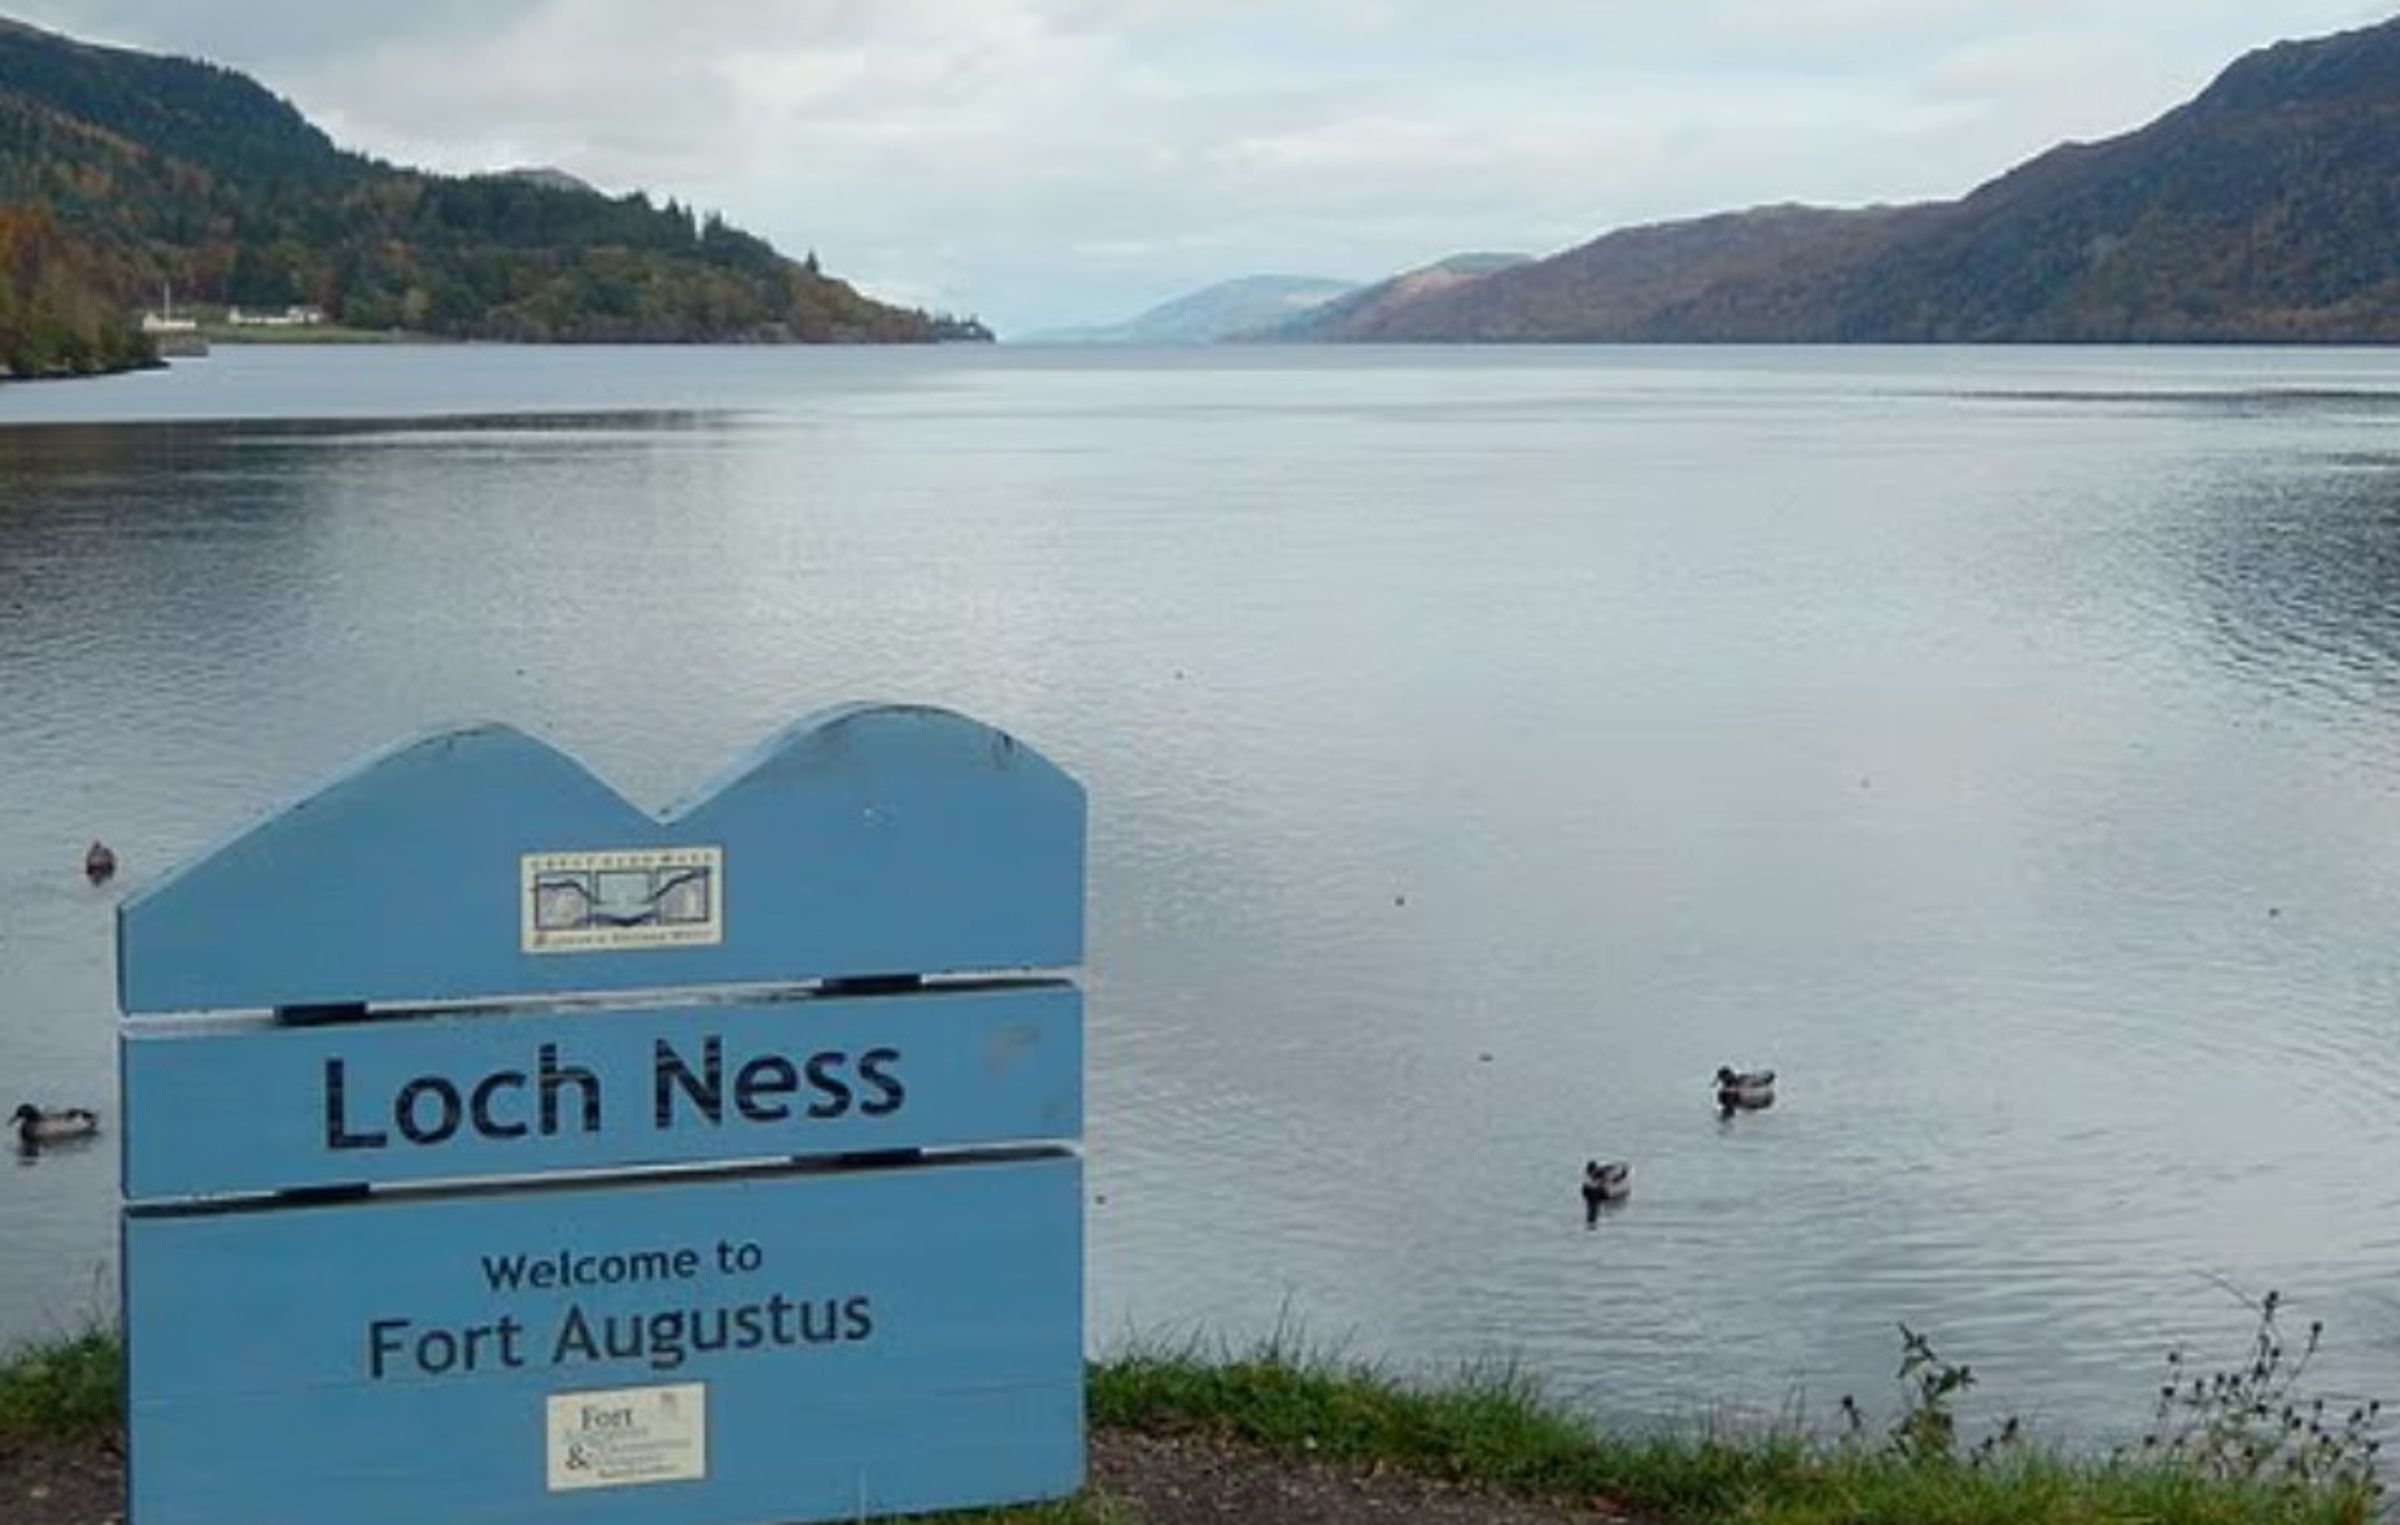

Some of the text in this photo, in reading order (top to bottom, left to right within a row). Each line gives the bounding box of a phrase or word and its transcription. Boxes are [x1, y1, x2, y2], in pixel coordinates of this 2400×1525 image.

[325, 1036, 905, 1150] Loch Ness
[482, 1241, 762, 1291] Welcome to
[370, 1294, 872, 1379] Fort Augustus
[581, 1405, 634, 1430] Fort
